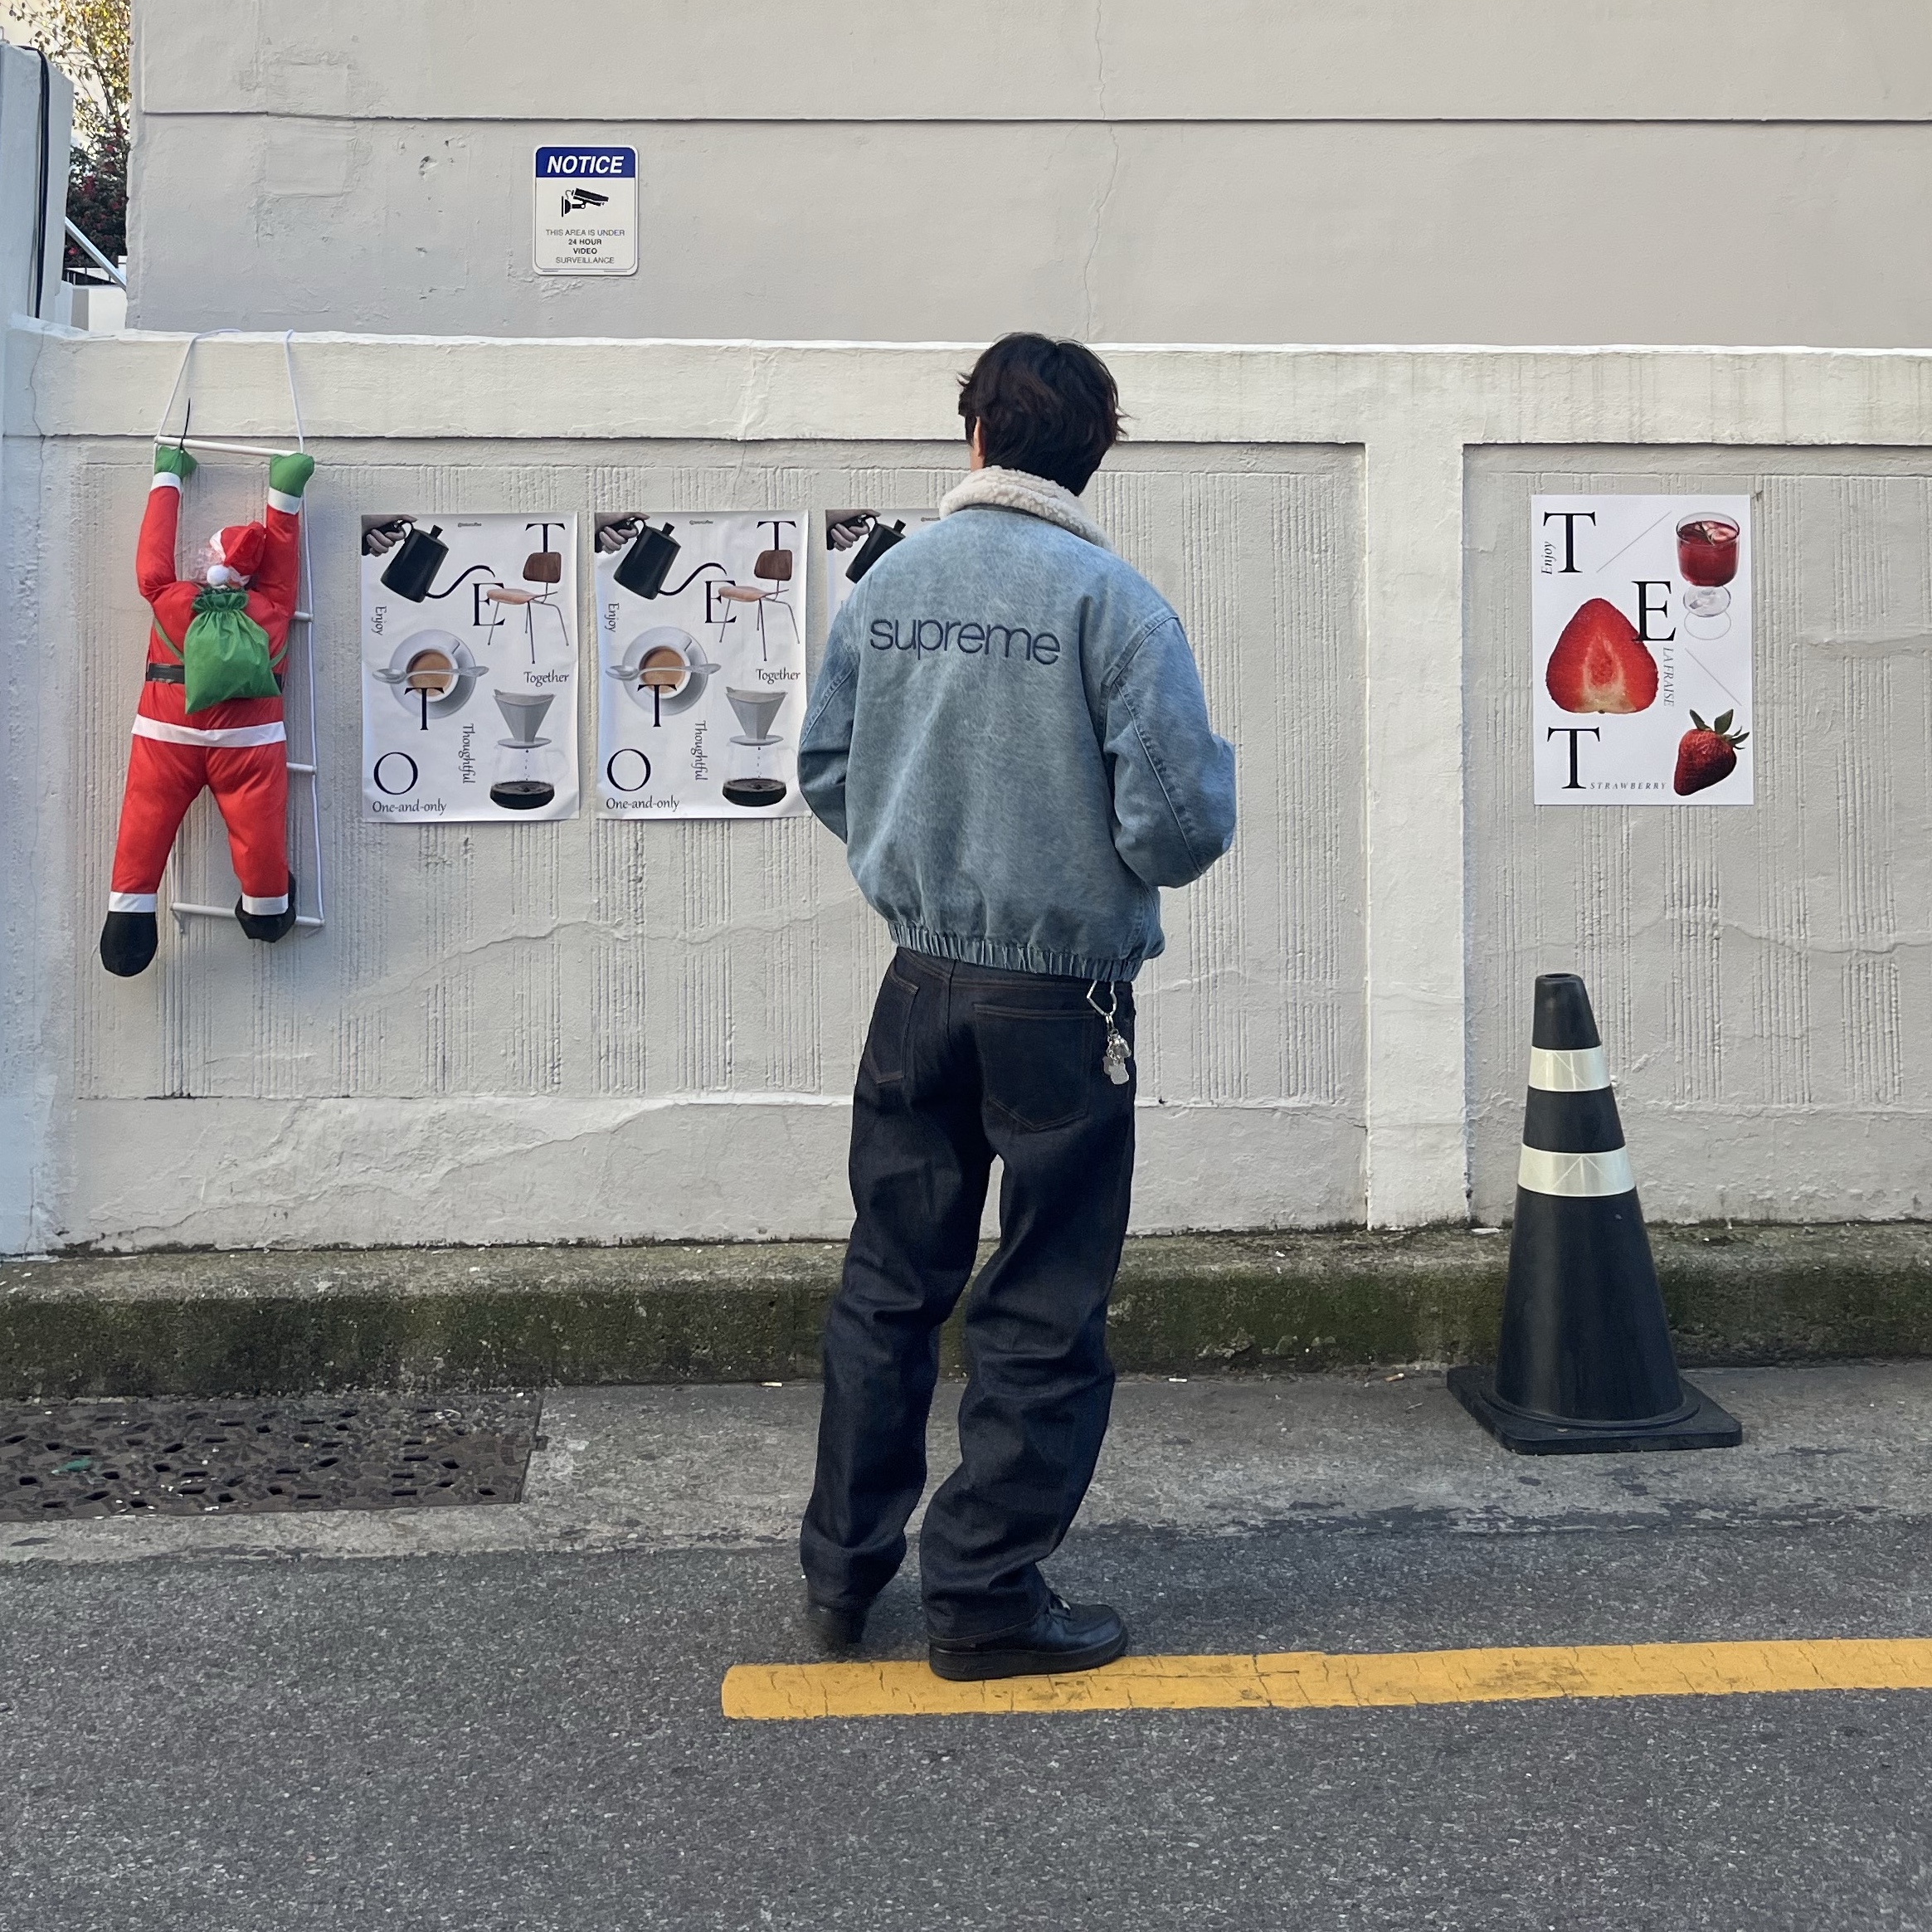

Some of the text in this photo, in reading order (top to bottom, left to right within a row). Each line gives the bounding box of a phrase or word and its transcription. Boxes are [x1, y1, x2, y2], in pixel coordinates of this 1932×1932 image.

[547, 155, 625, 174] NOTICE
[1540, 541, 1557, 575] Enjoy
[1543, 511, 1597, 573] T
[372, 606, 388, 636] Enjoy
[473, 582, 506, 626] E
[604, 602, 620, 633] Enjoy
[705, 581, 737, 624] E
[1631, 581, 1677, 642] E
[870, 618, 1061, 665] supreme
[523, 670, 570, 687] Together
[756, 667, 801, 684] Together
[404, 687, 445, 731] T
[637, 684, 677, 728] T
[458, 723, 476, 784] Thoughtful
[606, 748, 651, 791] O
[689, 720, 708, 781] Thoughtful
[1546, 727, 1600, 790] T
[373, 752, 418, 795] O
[372, 799, 447, 817] One-and-only
[606, 798, 680, 815] One-and-only
